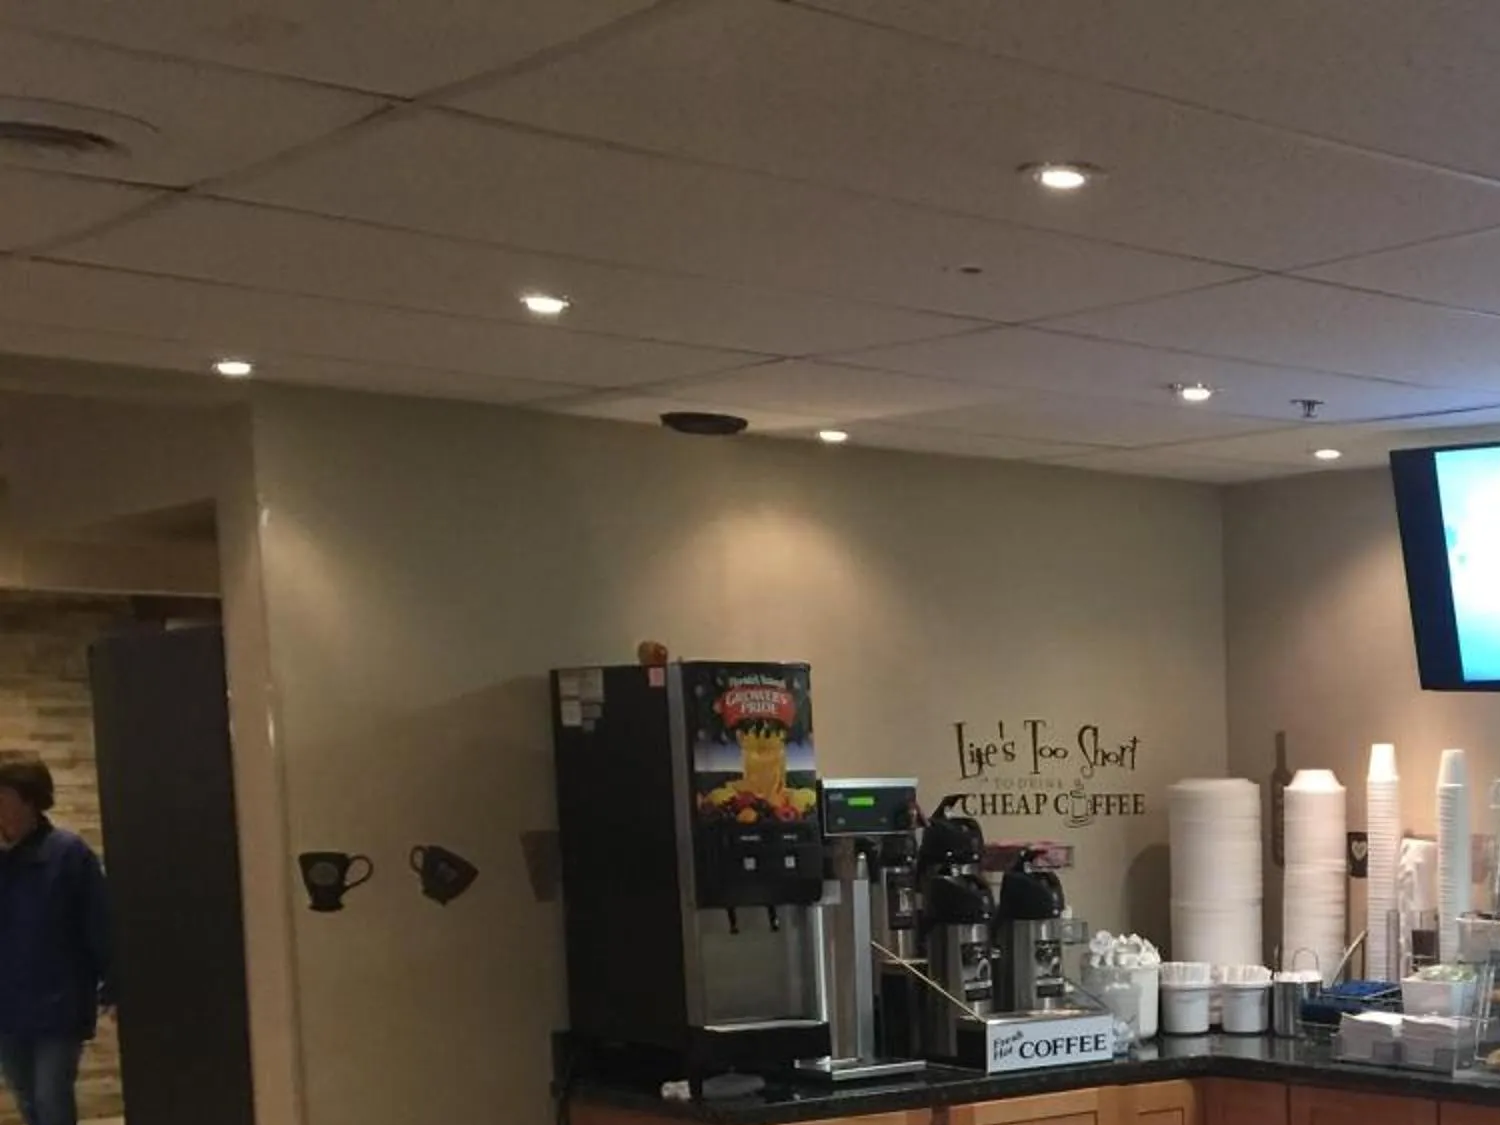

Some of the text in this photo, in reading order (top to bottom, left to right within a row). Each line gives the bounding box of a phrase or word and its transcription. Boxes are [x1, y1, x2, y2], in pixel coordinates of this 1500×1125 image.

[739, 701, 778, 715] PRIDE
[950, 720, 1141, 780] Life's Too Short
[961, 793, 1048, 817] CHEAP
[1019, 1033, 1107, 1059] COFFEE
